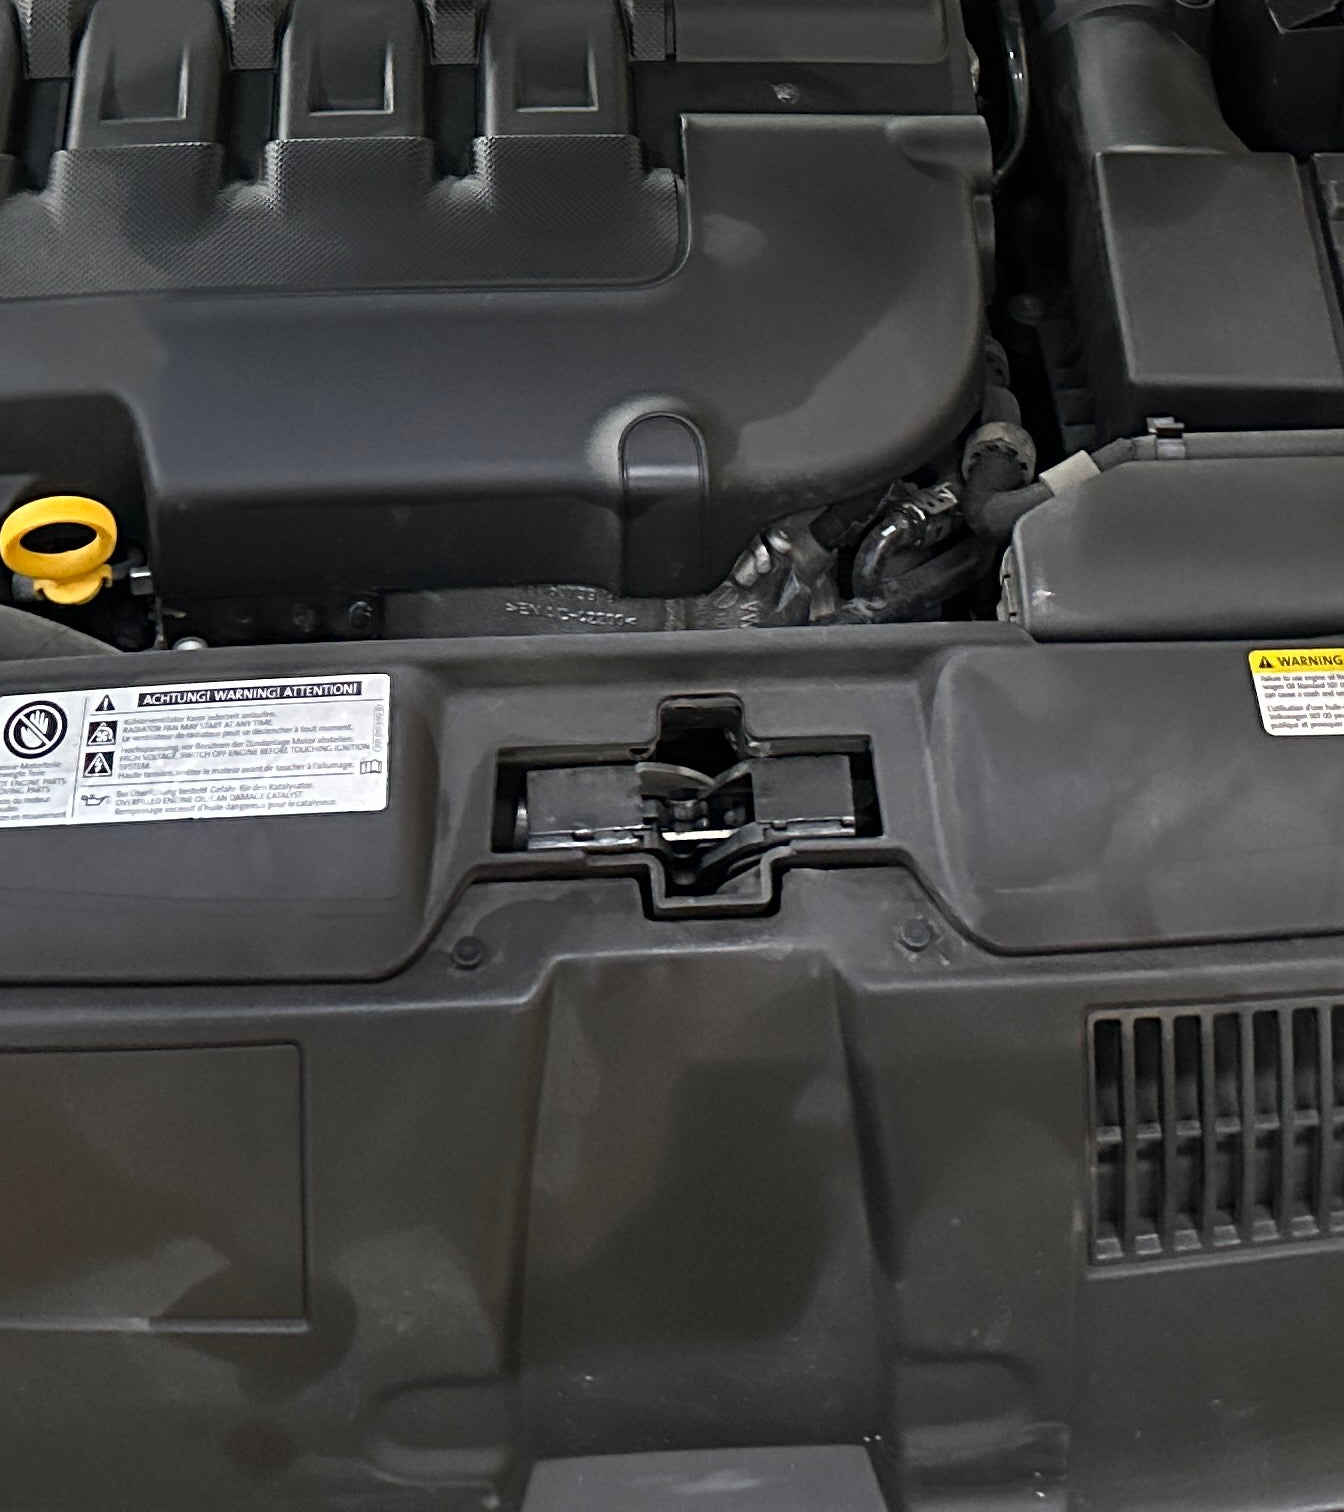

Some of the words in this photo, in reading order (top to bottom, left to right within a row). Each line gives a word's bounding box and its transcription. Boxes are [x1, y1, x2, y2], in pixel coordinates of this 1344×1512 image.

[1277, 655, 1343, 666] WARNING
[142, 690, 210, 706] ACHTUNG!
[213, 686, 281, 702] WARNING!
[282, 682, 357, 699] ATTENTION!
